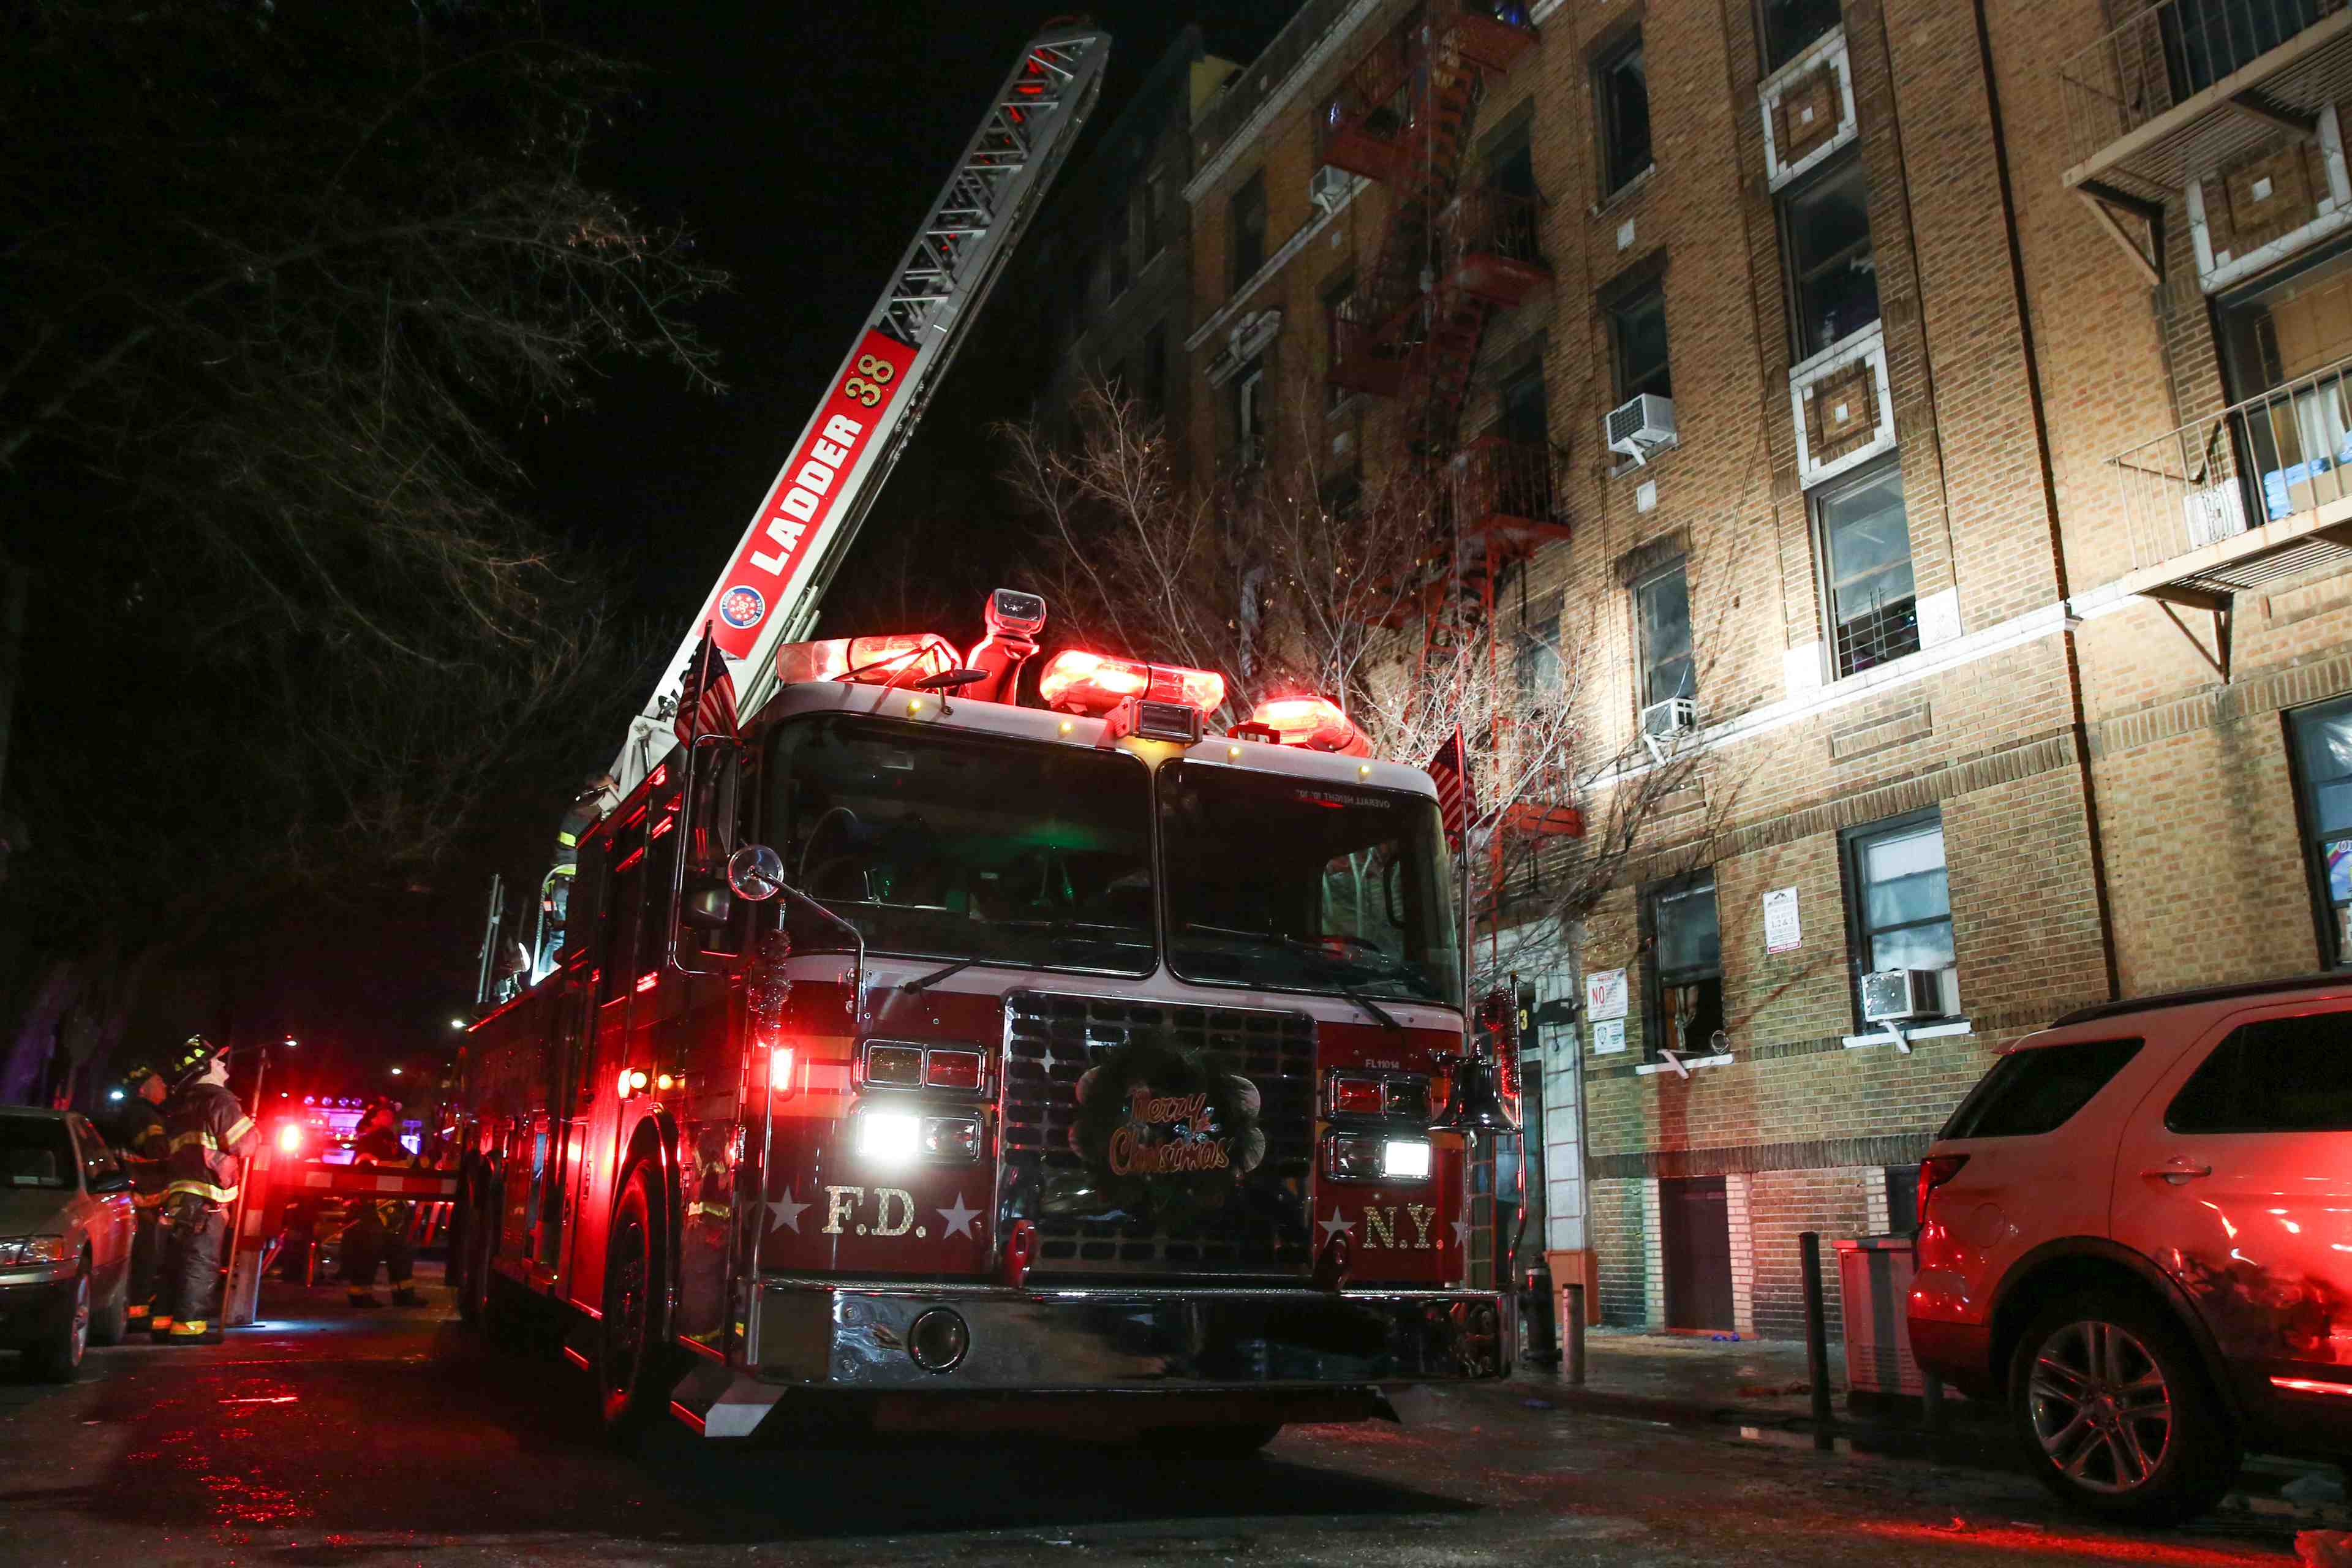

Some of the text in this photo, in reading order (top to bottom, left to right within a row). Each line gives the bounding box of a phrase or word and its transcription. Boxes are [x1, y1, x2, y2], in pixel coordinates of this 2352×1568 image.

[750, 353, 895, 576] LADDER 38
[1592, 986, 1605, 1005] NO
[1365, 1059, 1400, 1070] FL11014
[1127, 1088, 1206, 1133] Merry
[1109, 1127, 1233, 1175] Christmas
[822, 1185, 926, 1238] F.D.
[1363, 1206, 1444, 1250] N.Y.
